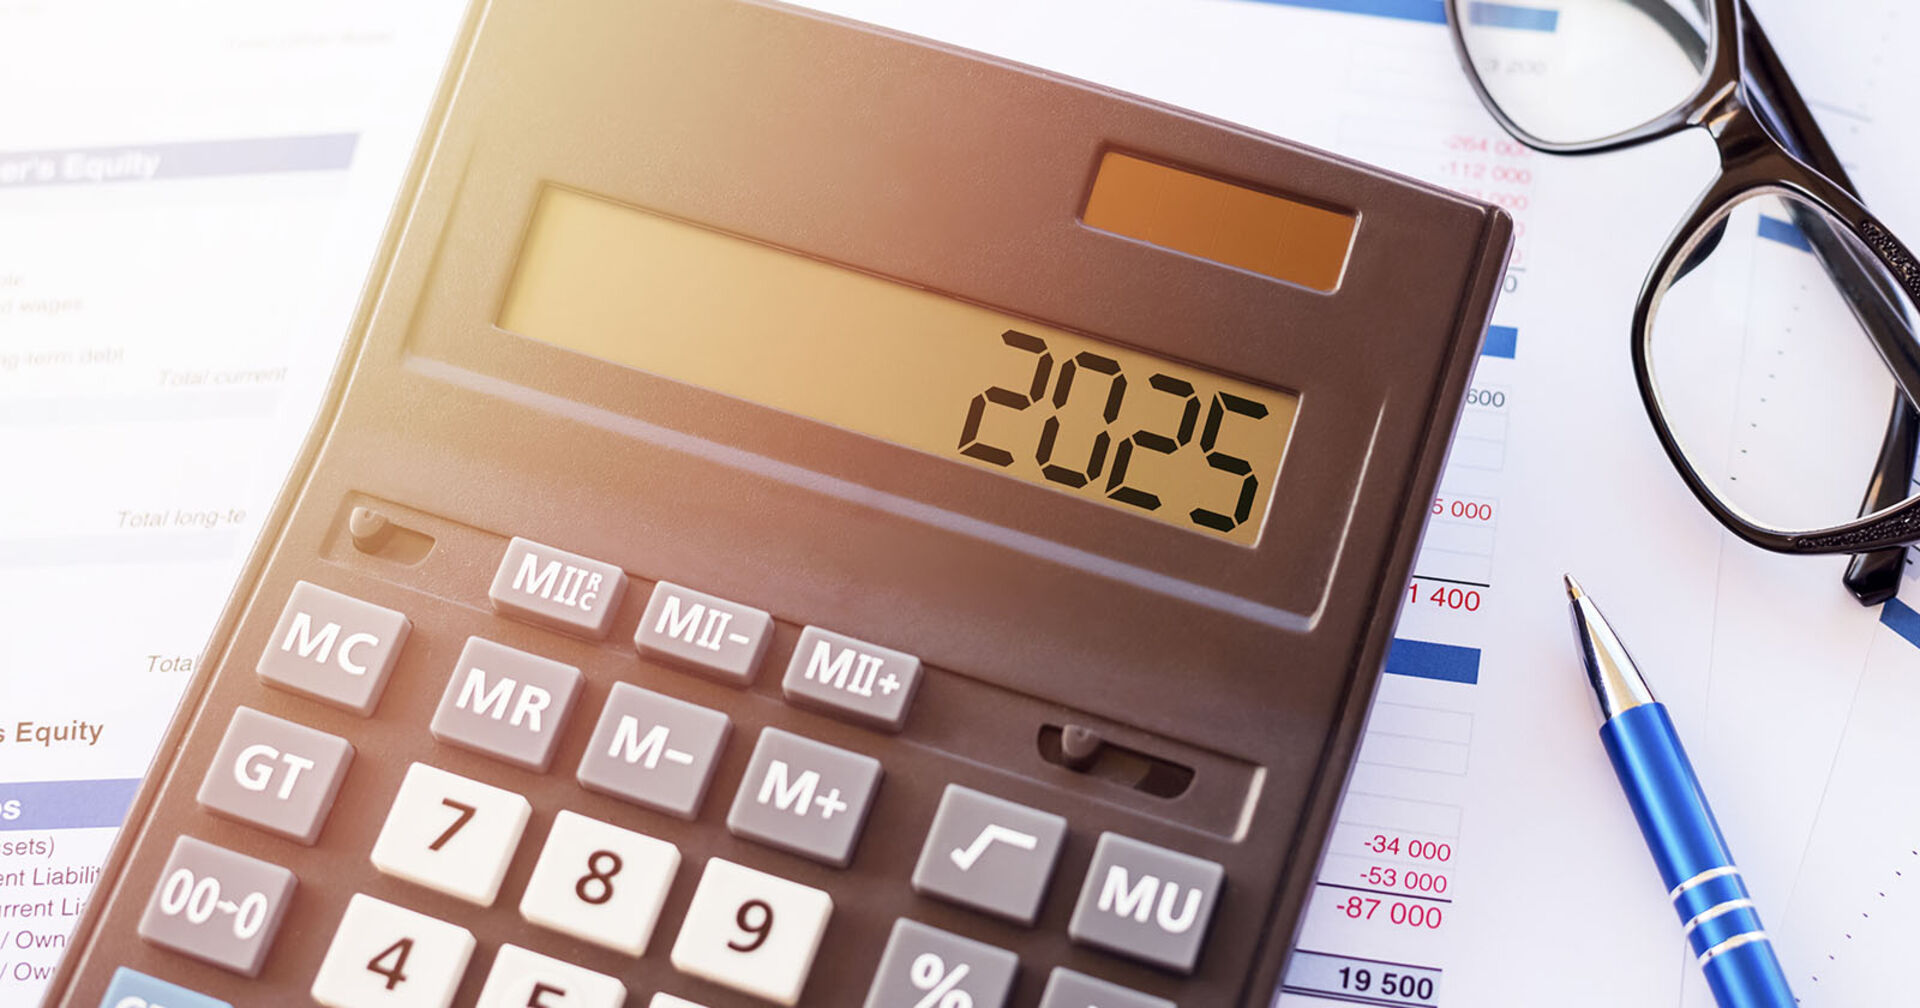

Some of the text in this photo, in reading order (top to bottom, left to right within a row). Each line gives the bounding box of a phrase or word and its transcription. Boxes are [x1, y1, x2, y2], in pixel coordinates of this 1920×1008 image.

[64, 149, 161, 183] Equity
[1491, 165, 1532, 185] 000
[158, 368, 209, 388] Total
[957, 329, 1269, 533] 2025
[117, 509, 167, 529] Total
[1451, 501, 1492, 521] 000
[1430, 586, 1481, 612] 400
[281, 612, 379, 675] MC
[455, 668, 551, 732] MR
[16, 719, 104, 747] Equity
[234, 744, 314, 800] GT
[757, 760, 848, 819] M+
[428, 798, 477, 851] 7
[1364, 834, 1451, 861] -34 000
[575, 850, 623, 905] 8
[1097, 864, 1203, 933] MU
[1360, 866, 1447, 893] -53 000
[727, 899, 774, 953] 9
[1336, 896, 1442, 929] -87 000
[367, 937, 415, 990] 4
[910, 953, 974, 1008] %
[1339, 967, 1433, 1000] 19 500
